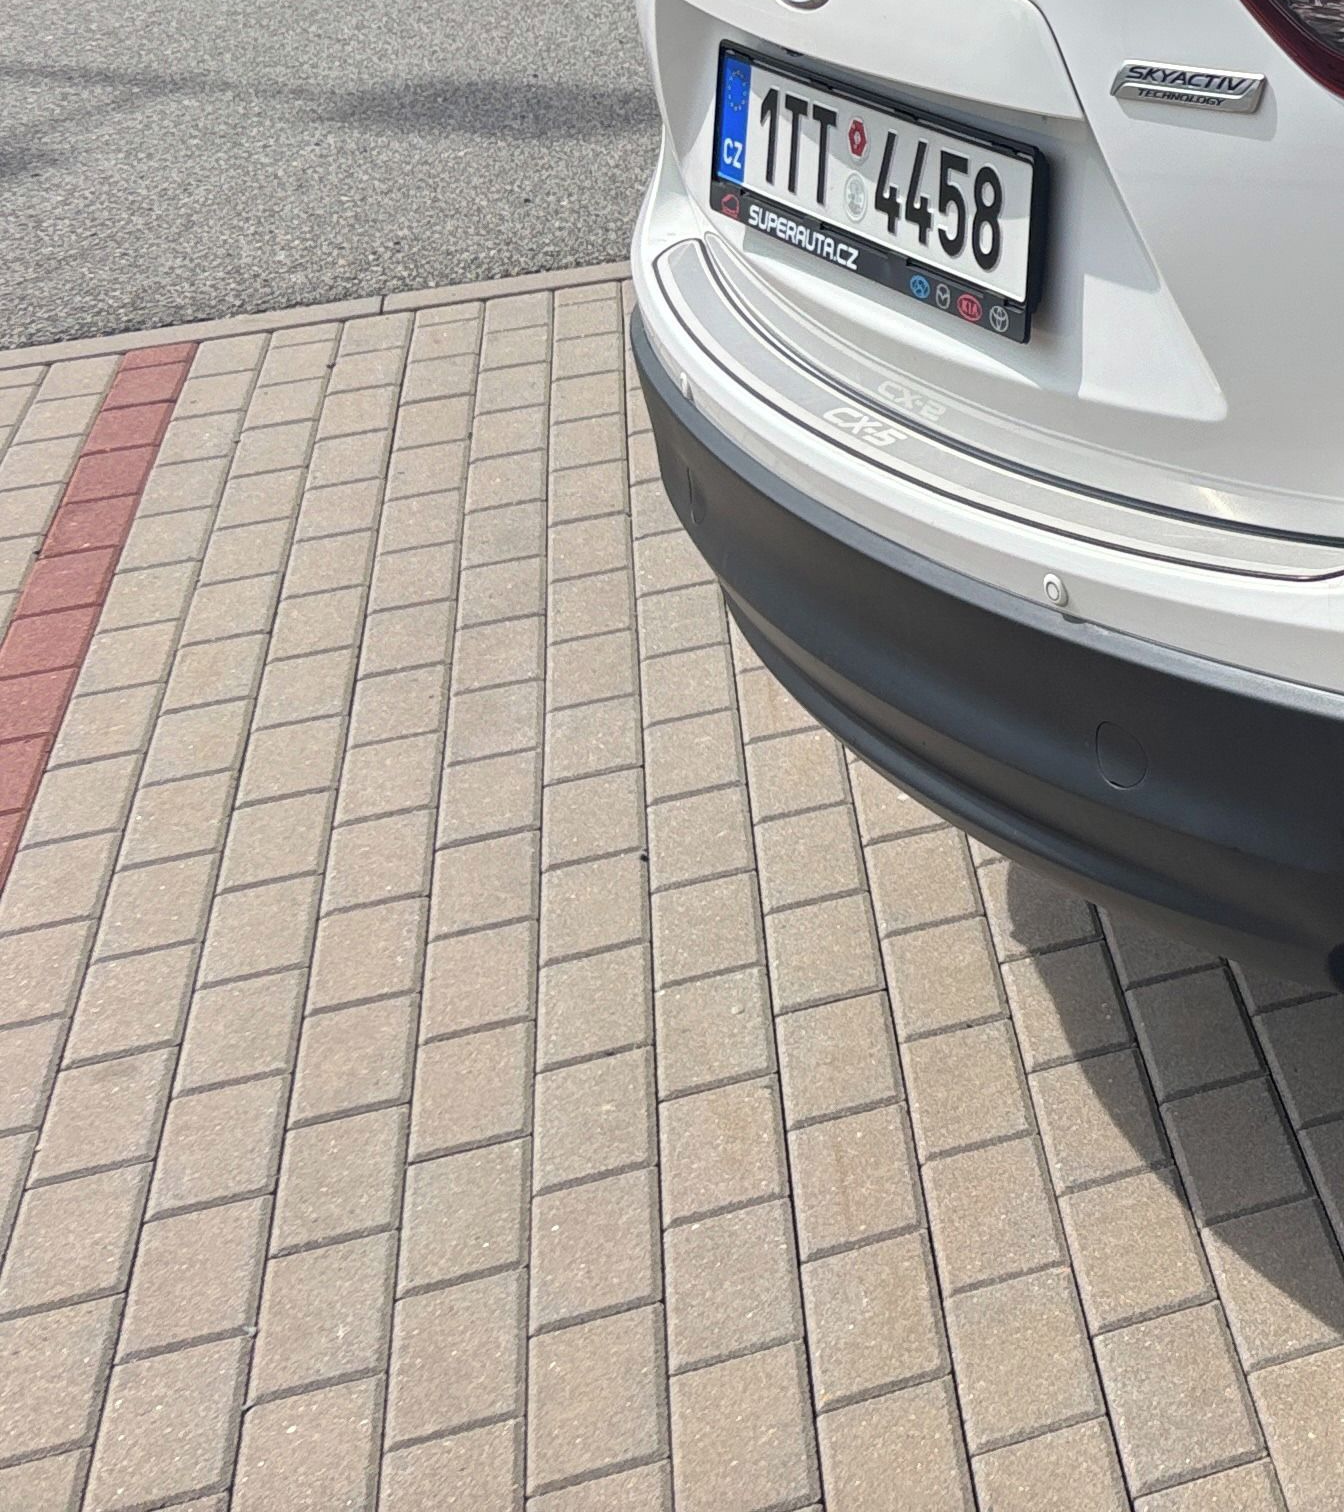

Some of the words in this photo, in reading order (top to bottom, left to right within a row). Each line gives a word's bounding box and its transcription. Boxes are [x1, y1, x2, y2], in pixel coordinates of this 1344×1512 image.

[1126, 65, 1248, 91] SKYACTIV
[1137, 87, 1226, 107] TECHNOLOGY
[723, 137, 743, 170] CZ
[760, 88, 838, 207] 1TT
[874, 129, 1003, 272] 4458
[748, 204, 860, 271] SUPERAUTA.CZ
[960, 299, 979, 316] KIA
[822, 406, 909, 448] CX-5
